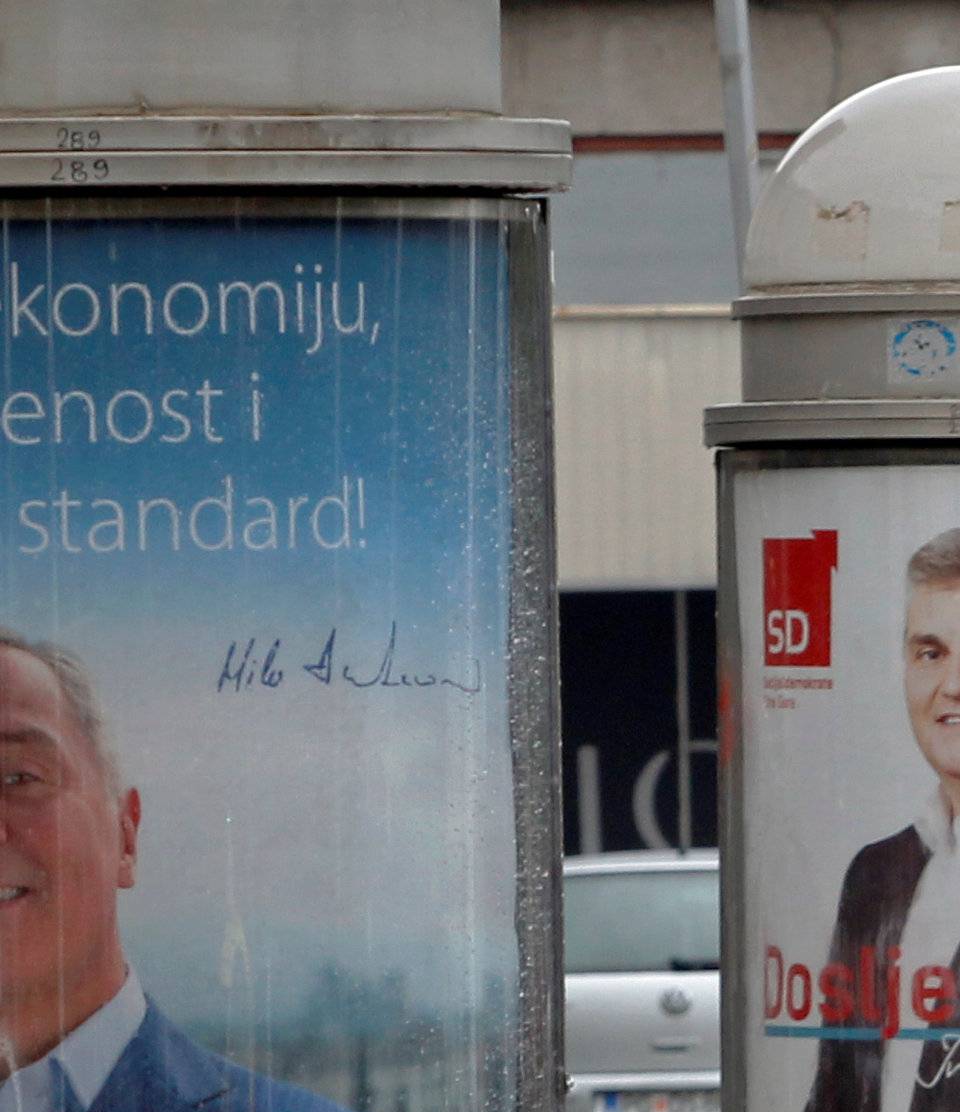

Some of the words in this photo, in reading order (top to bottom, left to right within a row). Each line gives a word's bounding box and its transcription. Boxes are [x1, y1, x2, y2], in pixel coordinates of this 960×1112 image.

[57, 127, 101, 149] 289
[51, 158, 109, 182] 289
[11, 262, 380, 355] konomiju,
[2, 379, 224, 444] enost
[250, 372, 261, 441] i
[19, 476, 367, 554] standard!
[767, 609, 809, 654] SD
